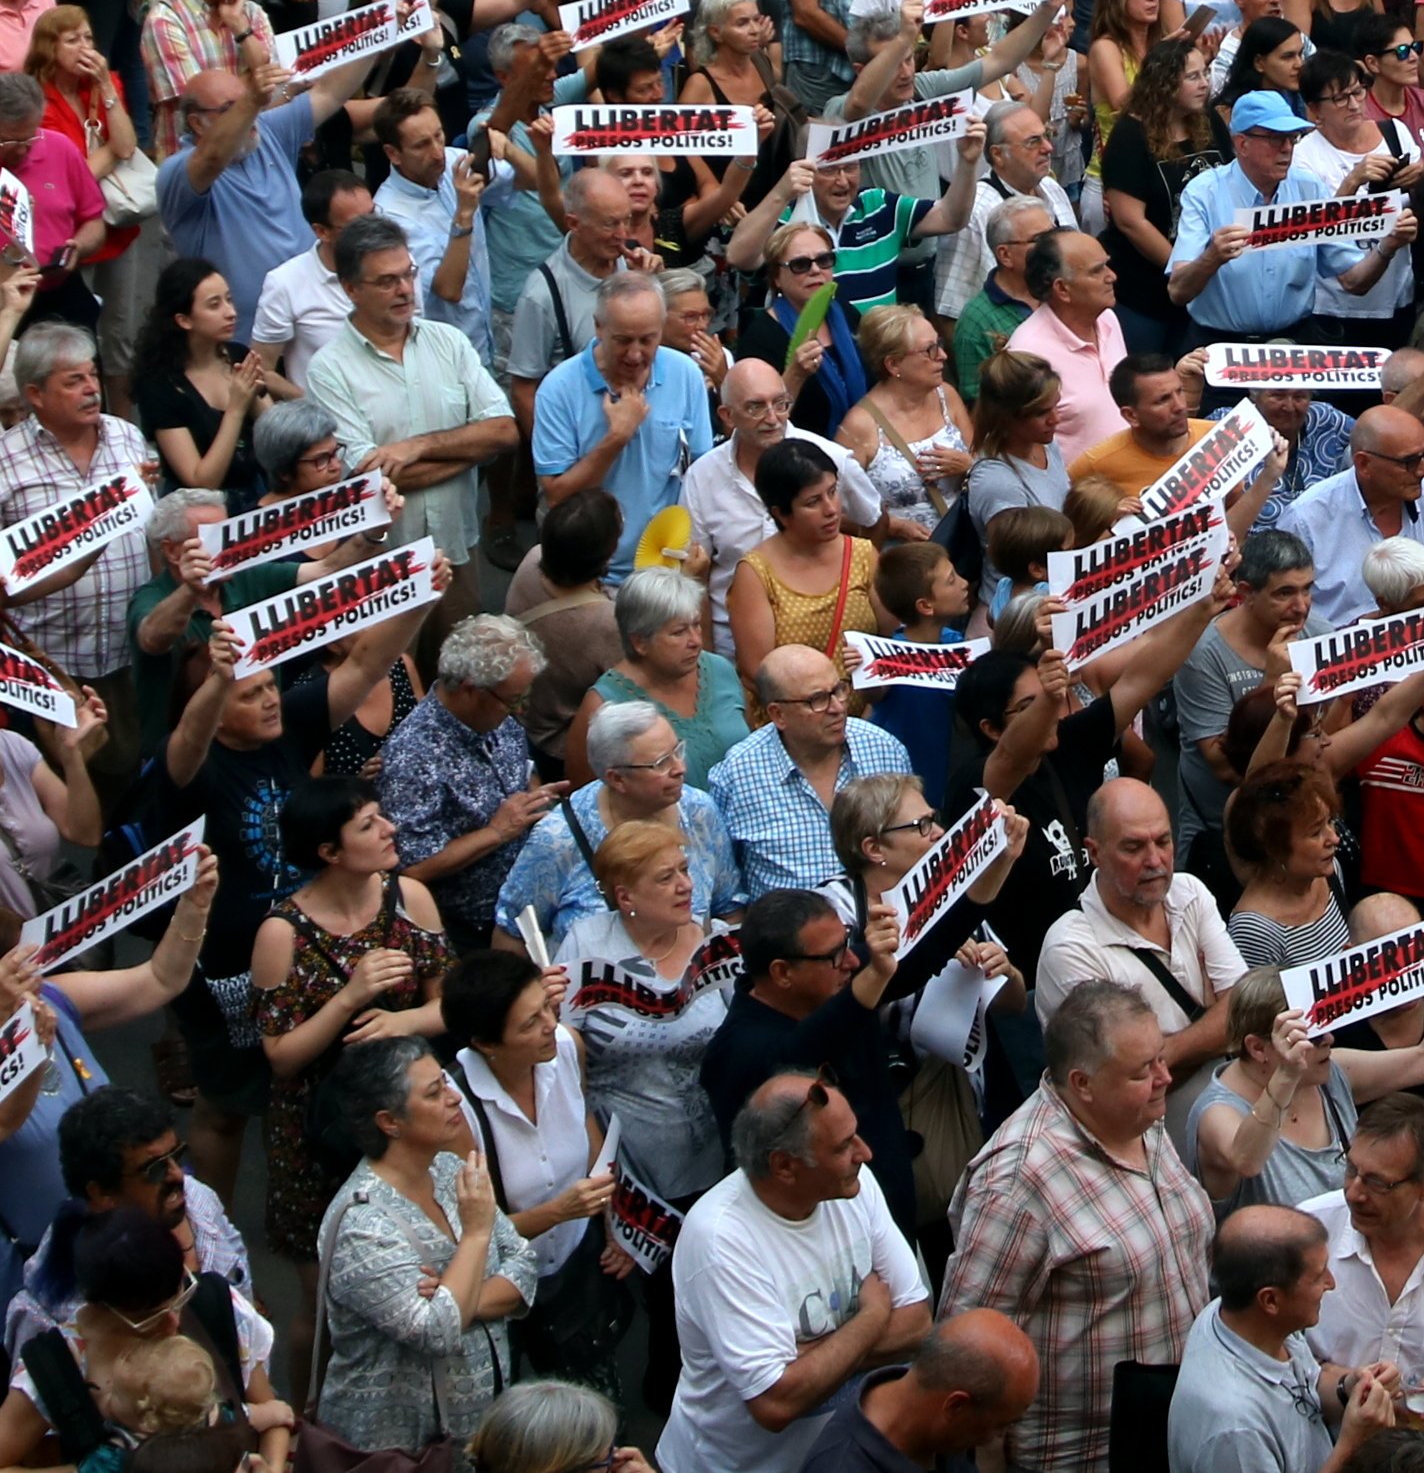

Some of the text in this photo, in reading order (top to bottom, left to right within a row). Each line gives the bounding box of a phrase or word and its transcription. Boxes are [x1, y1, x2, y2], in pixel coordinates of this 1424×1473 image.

[575, 110, 732, 132] LLIBERTAT
[828, 97, 954, 140] LLIBERTAT
[1256, 196, 1383, 230] LLIBERTAT
[1225, 348, 1379, 369] LLIBERTAT
[1138, 415, 1248, 525] LLIBERTAT
[4, 479, 131, 560] LLIBERTAT
[220, 481, 364, 548] LLIBERTAT
[1075, 506, 1213, 579] LLIBERTAT
[248, 552, 412, 640] LLIBERTAT
[1076, 549, 1205, 638] LLIBERTAT
[45, 833, 191, 939] LLIBERTAT
[903, 800, 997, 907] LLIBERTAT
